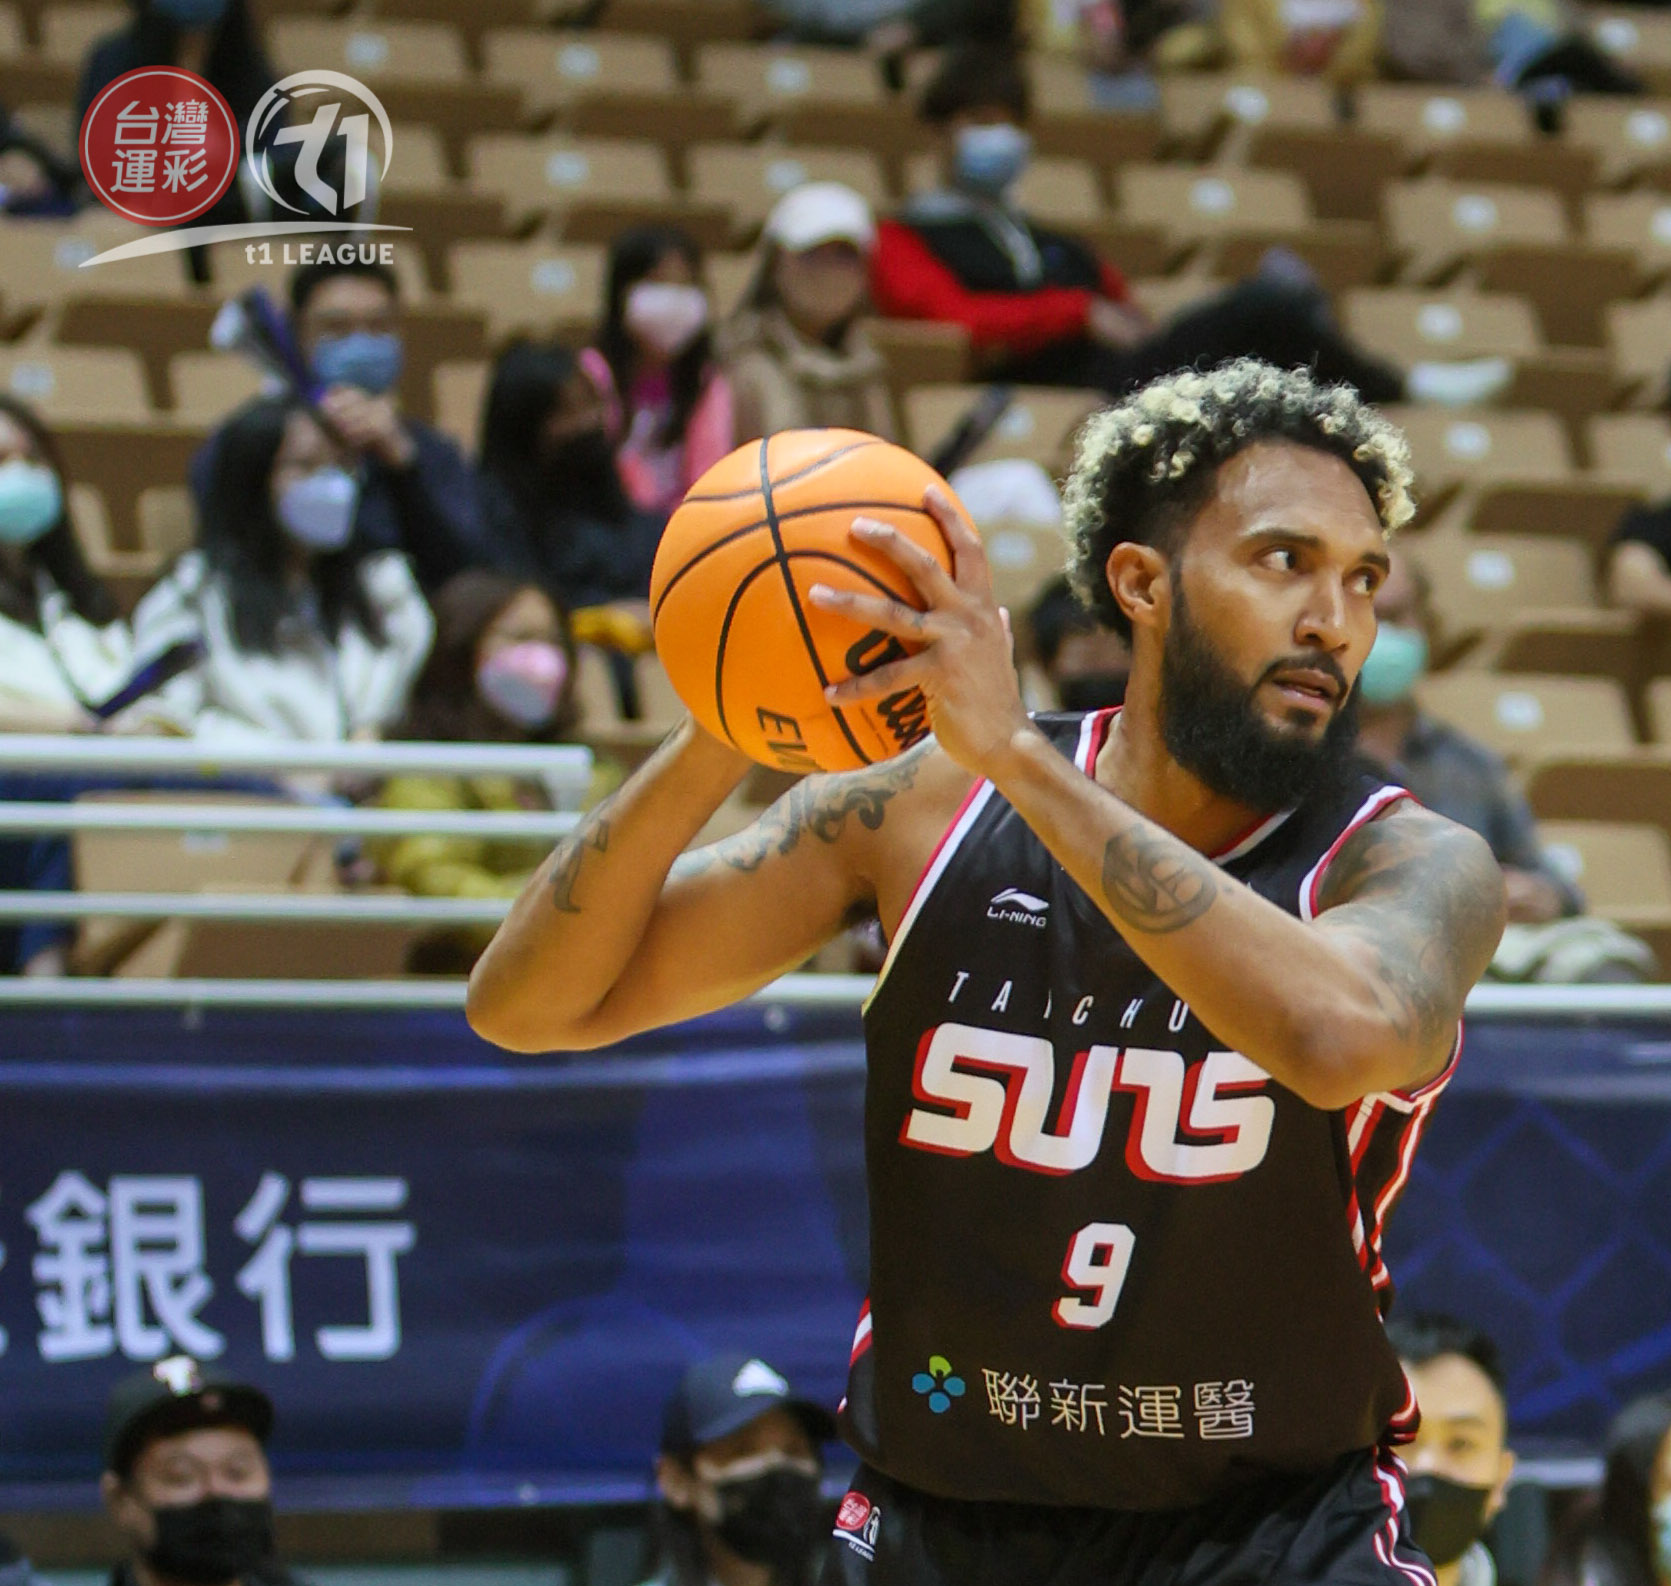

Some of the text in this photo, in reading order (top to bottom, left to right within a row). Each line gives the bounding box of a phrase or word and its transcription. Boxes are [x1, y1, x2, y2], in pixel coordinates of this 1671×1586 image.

[986, 906, 1048, 928] LI-NING
[948, 970, 1187, 1034] TAICHU
[0, 1169, 417, 1364] 銀行
[1051, 1222, 1137, 1331] 9
[981, 1367, 1256, 1441] 聯新運醫
